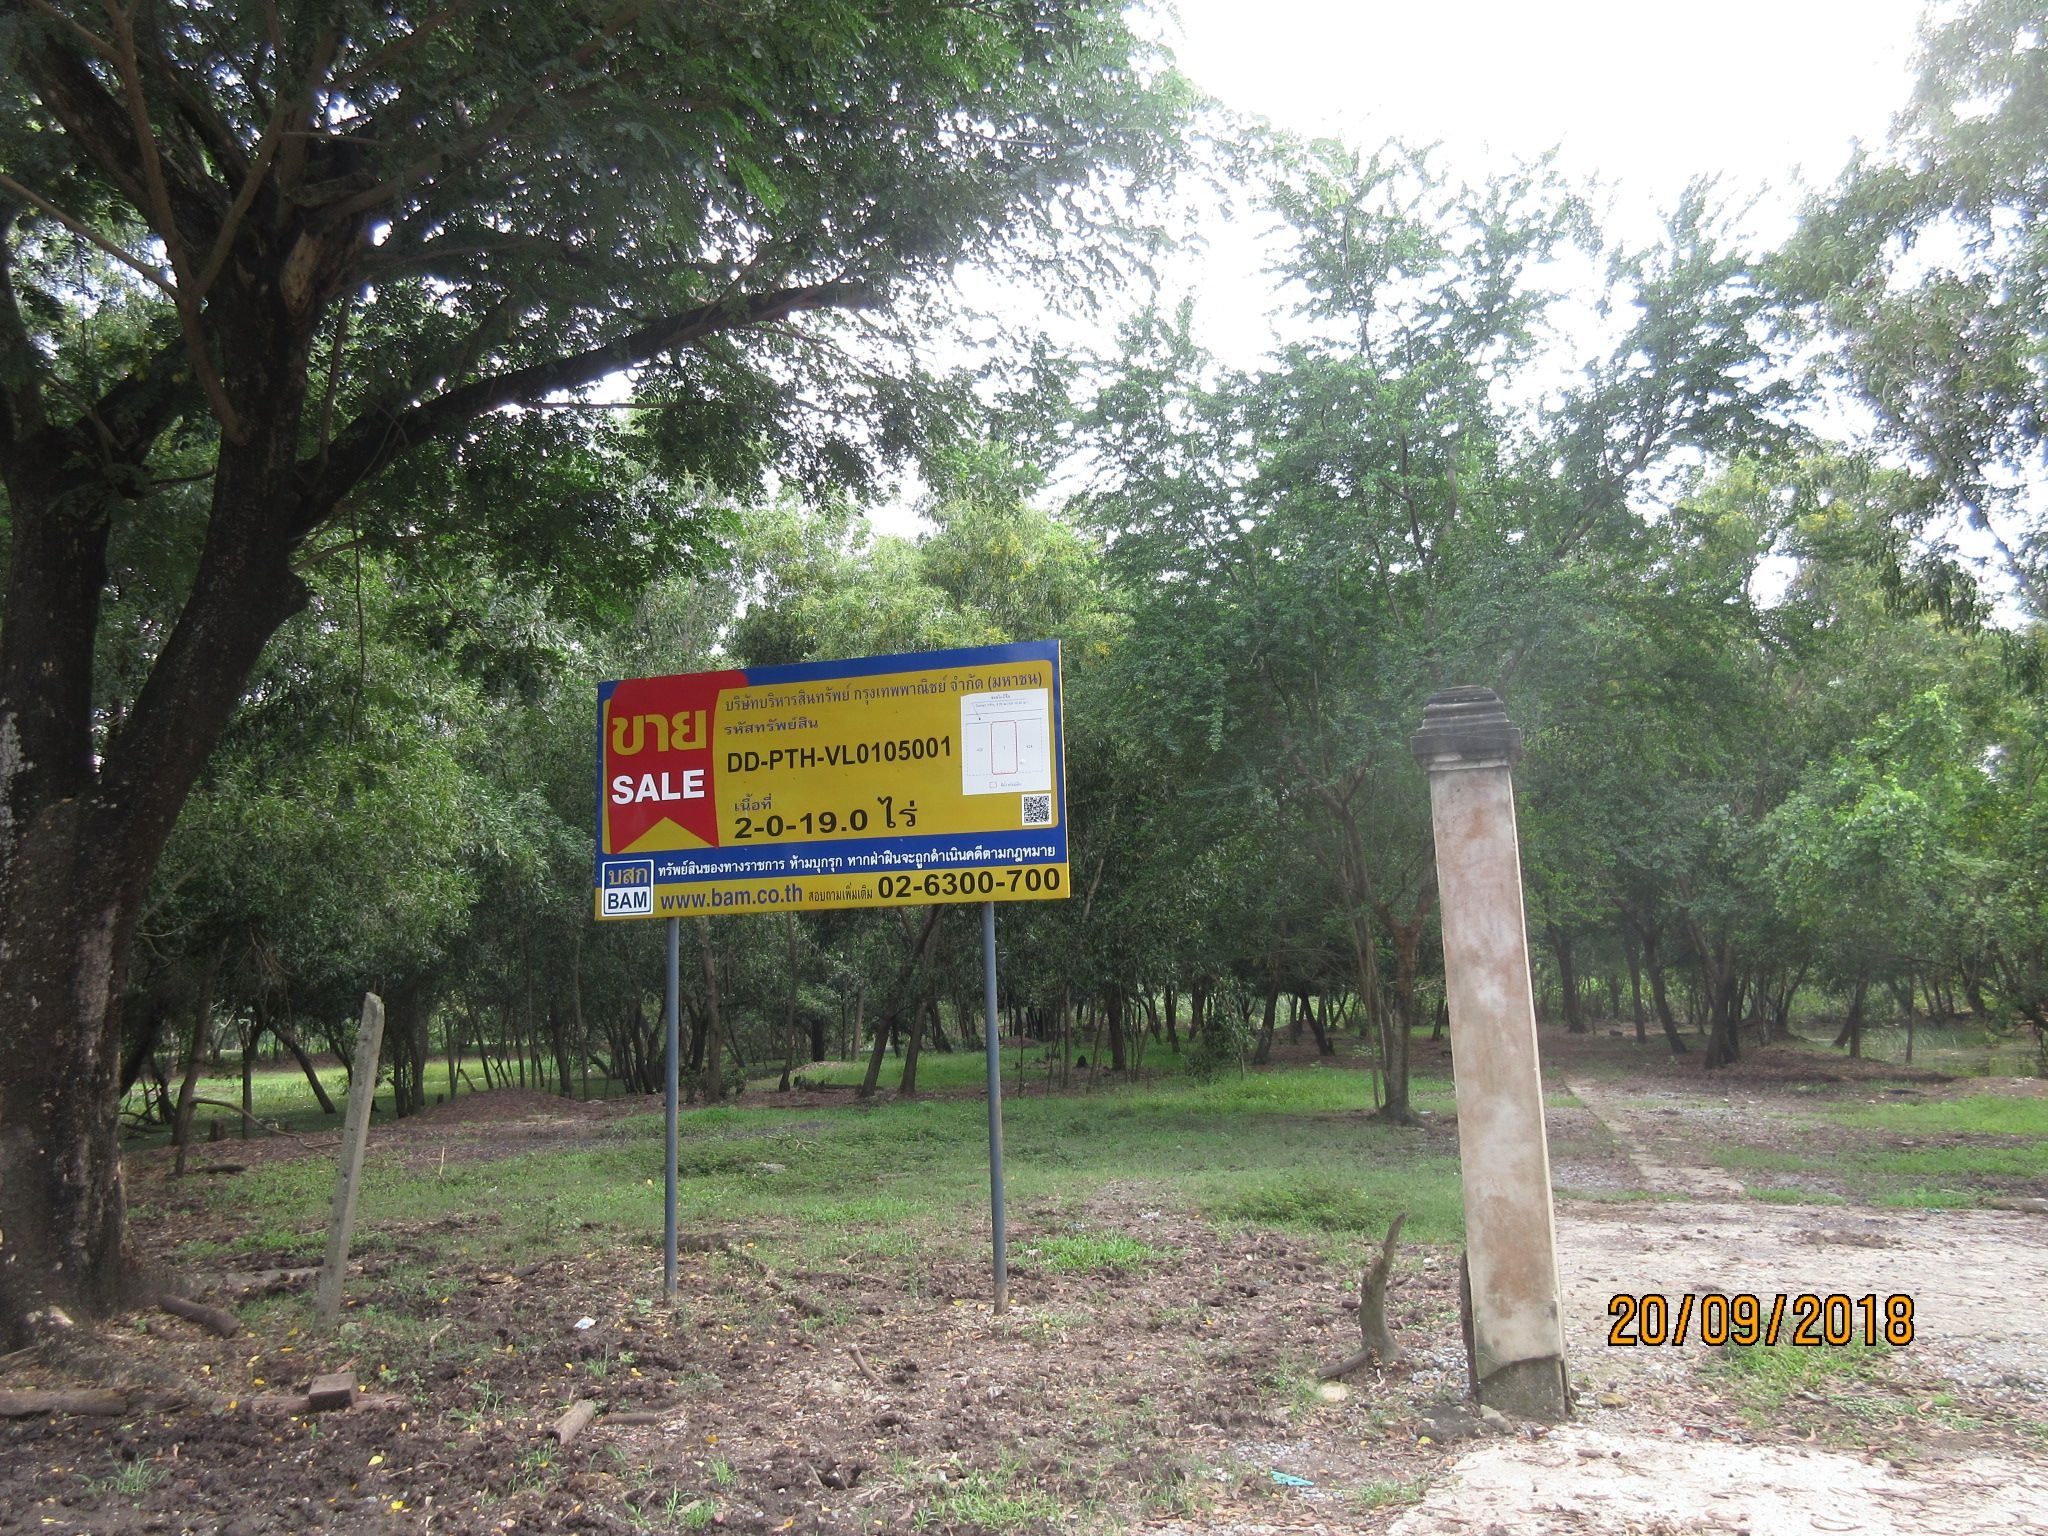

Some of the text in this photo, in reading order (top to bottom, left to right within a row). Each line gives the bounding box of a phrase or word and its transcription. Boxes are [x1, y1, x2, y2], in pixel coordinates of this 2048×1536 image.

[854, 676, 945, 707] กรุงเทพพาณิชย์
[951, 673, 983, 692] จำกัด
[988, 671, 1043, 692] (มหาชน)
[612, 710, 706, 755] ขาย
[724, 716, 819, 735] รหัสทรัพย์สิน
[728, 736, 952, 773] DD-PTH-VL0105001
[611, 769, 705, 804] SALE
[735, 793, 772, 812] เนื้อที่
[735, 796, 918, 839] 2-0-19.0 ไร่
[608, 867, 648, 886] บสก
[658, 858, 785, 877] ทรัพย์สินของทางราชการ
[790, 855, 843, 875] ห้ามบุกรุก
[661, 883, 802, 910] www.bam.co.th
[878, 867, 1061, 899] 02-6300-700
[607, 891, 648, 910] BAM
